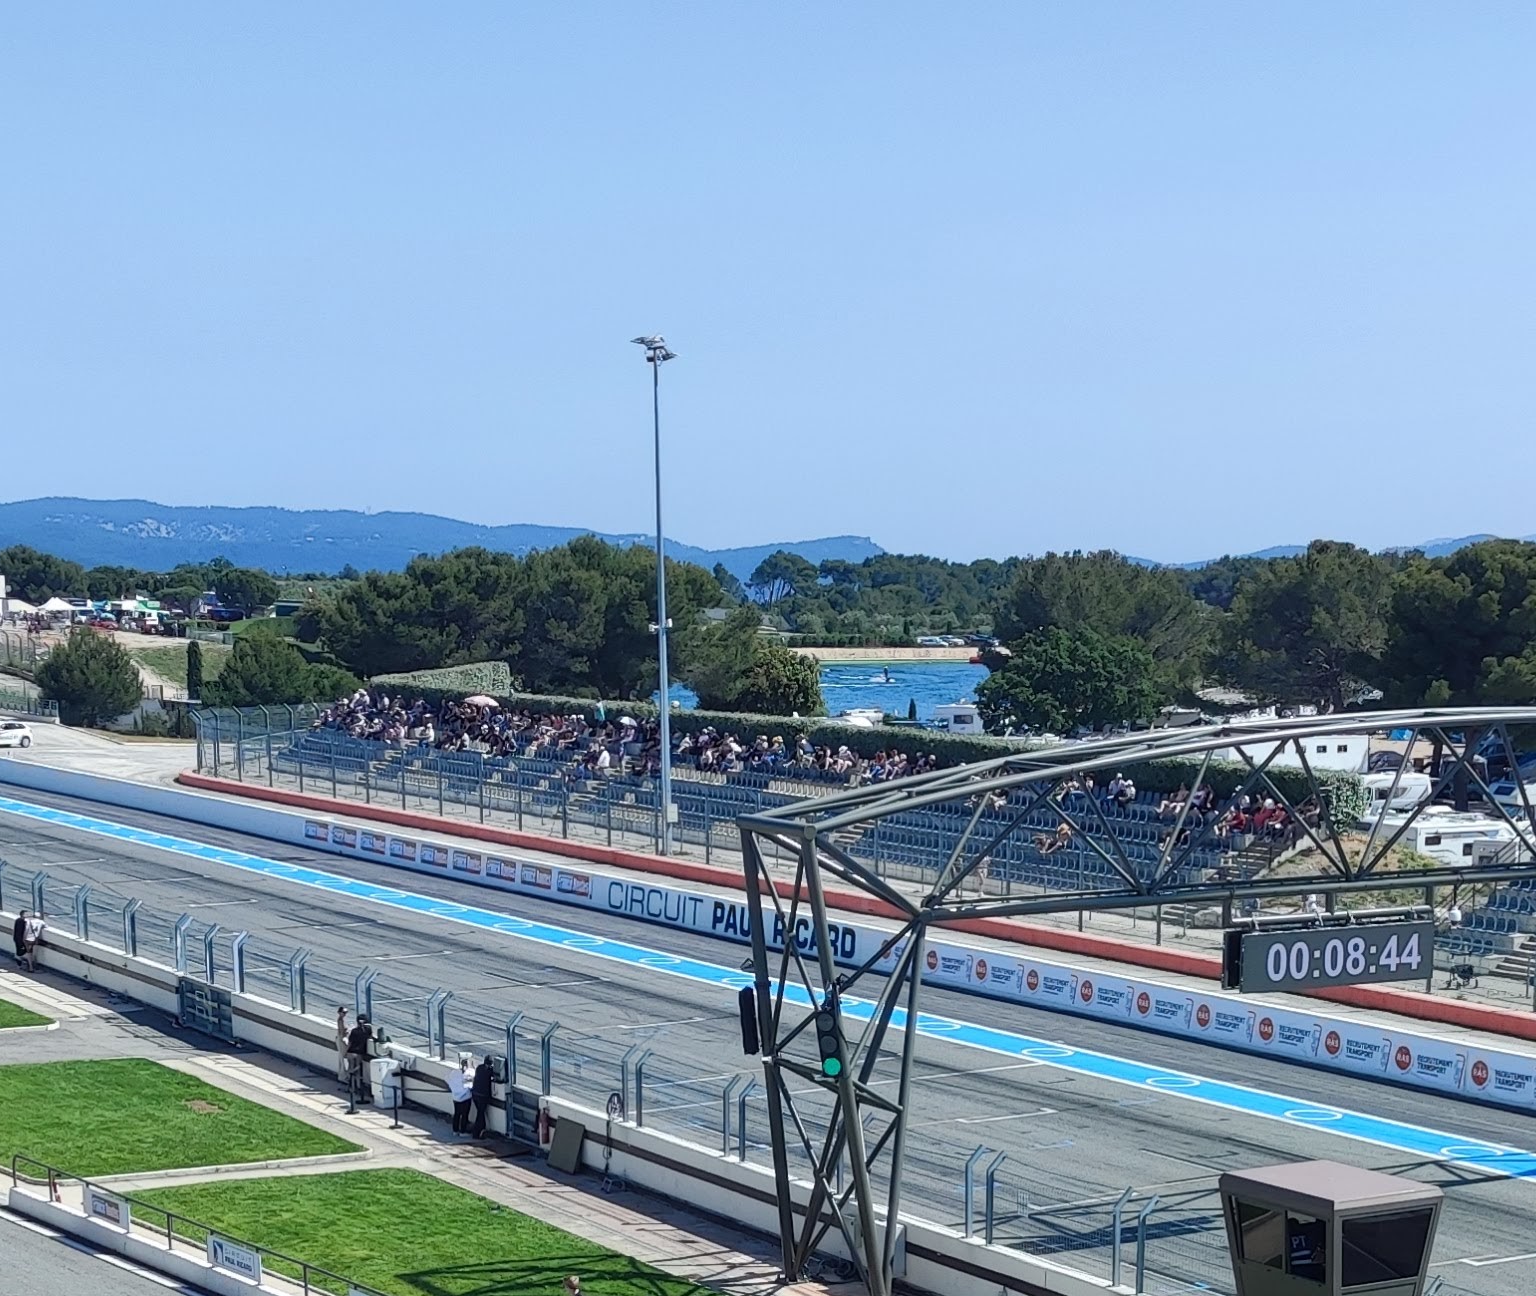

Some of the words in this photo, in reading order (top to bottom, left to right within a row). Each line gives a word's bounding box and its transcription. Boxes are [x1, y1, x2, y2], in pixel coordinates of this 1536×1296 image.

[607, 881, 703, 926] CIRCUIT
[711, 901, 752, 938] PAU
[1267, 933, 1422, 982] 00:08:44
[1291, 1235, 1306, 1249] PT
